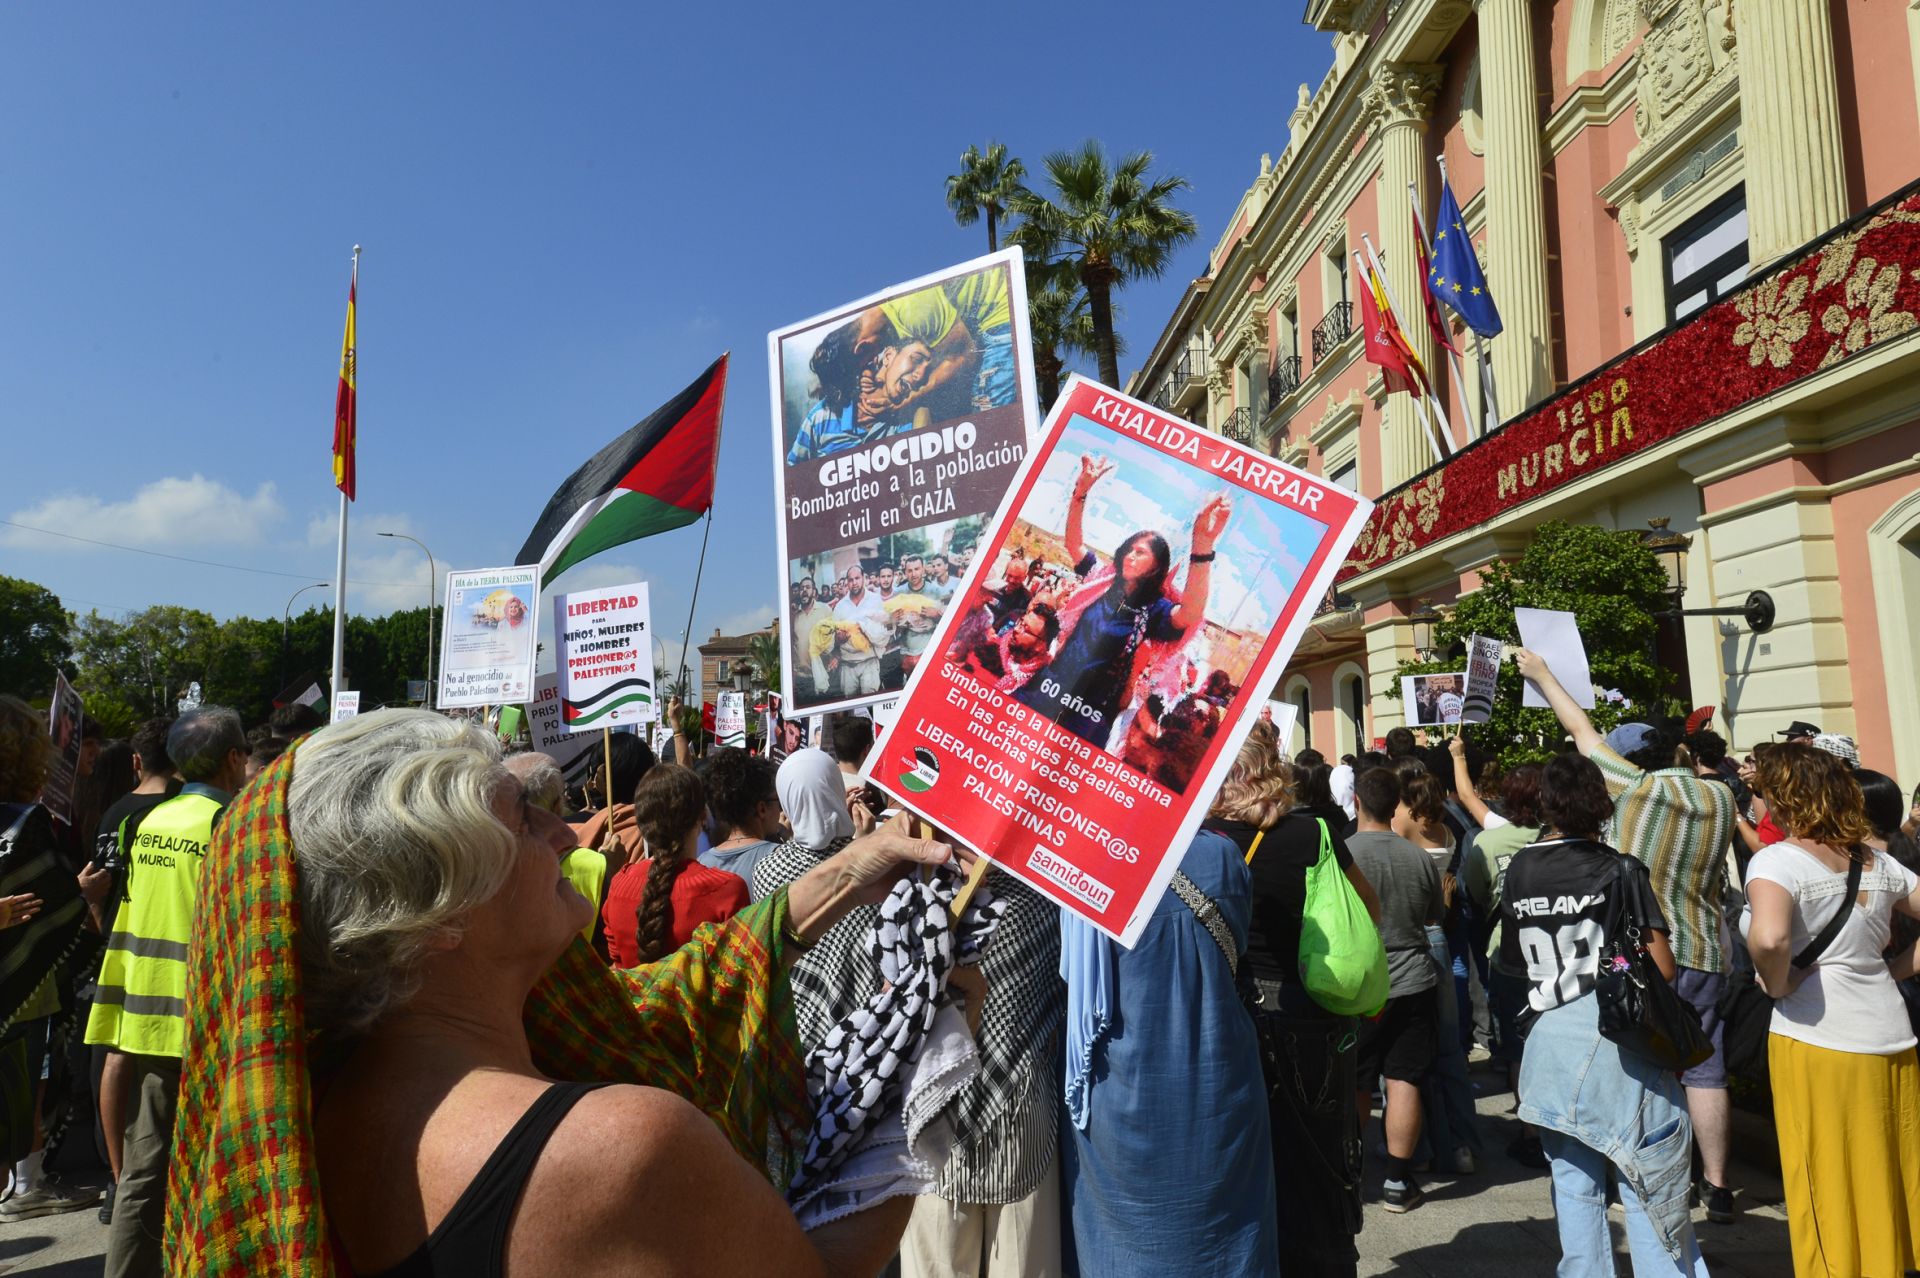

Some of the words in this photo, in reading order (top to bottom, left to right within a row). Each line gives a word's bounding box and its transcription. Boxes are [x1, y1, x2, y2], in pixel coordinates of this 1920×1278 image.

[1556, 378, 1629, 432] 1200
[818, 421, 977, 487] GENOCIDIO
[1091, 395, 1199, 459] KHALIDA
[1210, 450, 1325, 513] JARRAR
[1498, 406, 1634, 499] MURCIA
[791, 478, 880, 520] Bombardeo
[889, 475, 900, 492] a
[909, 464, 926, 487] la
[936, 440, 1023, 487] población
[839, 508, 871, 538] civil
[880, 508, 900, 527] en
[910, 488, 956, 519] GAZA
[480, 576, 500, 586] TIERRA
[502, 574, 533, 584] PALESTINA
[567, 595, 639, 617] LIBERTAD
[563, 628, 597, 643] NIÑOS,
[598, 622, 645, 637] MUJERES
[580, 637, 630, 653] HOMBRES
[568, 649, 638, 669] PRISIONER@S
[1473, 647, 1500, 660] SINOS
[446, 673, 456, 684] No
[458, 672, 465, 683] al
[466, 668, 504, 685] genocidio
[573, 663, 637, 681] PALESTIN@S
[445, 686, 468, 698] Pueblo
[469, 684, 499, 696] Palestino
[1040, 678, 1060, 698] 60
[1060, 693, 1104, 724] años
[531, 704, 559, 719] PRISI
[543, 720, 559, 731] PO
[940, 662, 1004, 709] Símbolo
[1006, 700, 1027, 721] de
[1028, 712, 1043, 732] la
[1044, 719, 1091, 761] lucha
[1094, 749, 1173, 808] palestina
[945, 689, 967, 710] En
[970, 701, 994, 724] las
[996, 716, 1061, 765] cárceles
[1064, 756, 1135, 809] israelíes
[919, 768, 936, 781] LIBRE
[967, 720, 1035, 766] muchas
[1029, 760, 1079, 794] veces
[915, 718, 1013, 787] LIBERACIÓN
[1013, 779, 1140, 864] PRISIONER@S
[962, 775, 1067, 847] PALESTINAS
[133, 832, 209, 858] Y@FLAUTAS
[137, 853, 176, 869] MURCIA
[1032, 850, 1109, 905] samidoun
[1518, 918, 1605, 1012] 98
